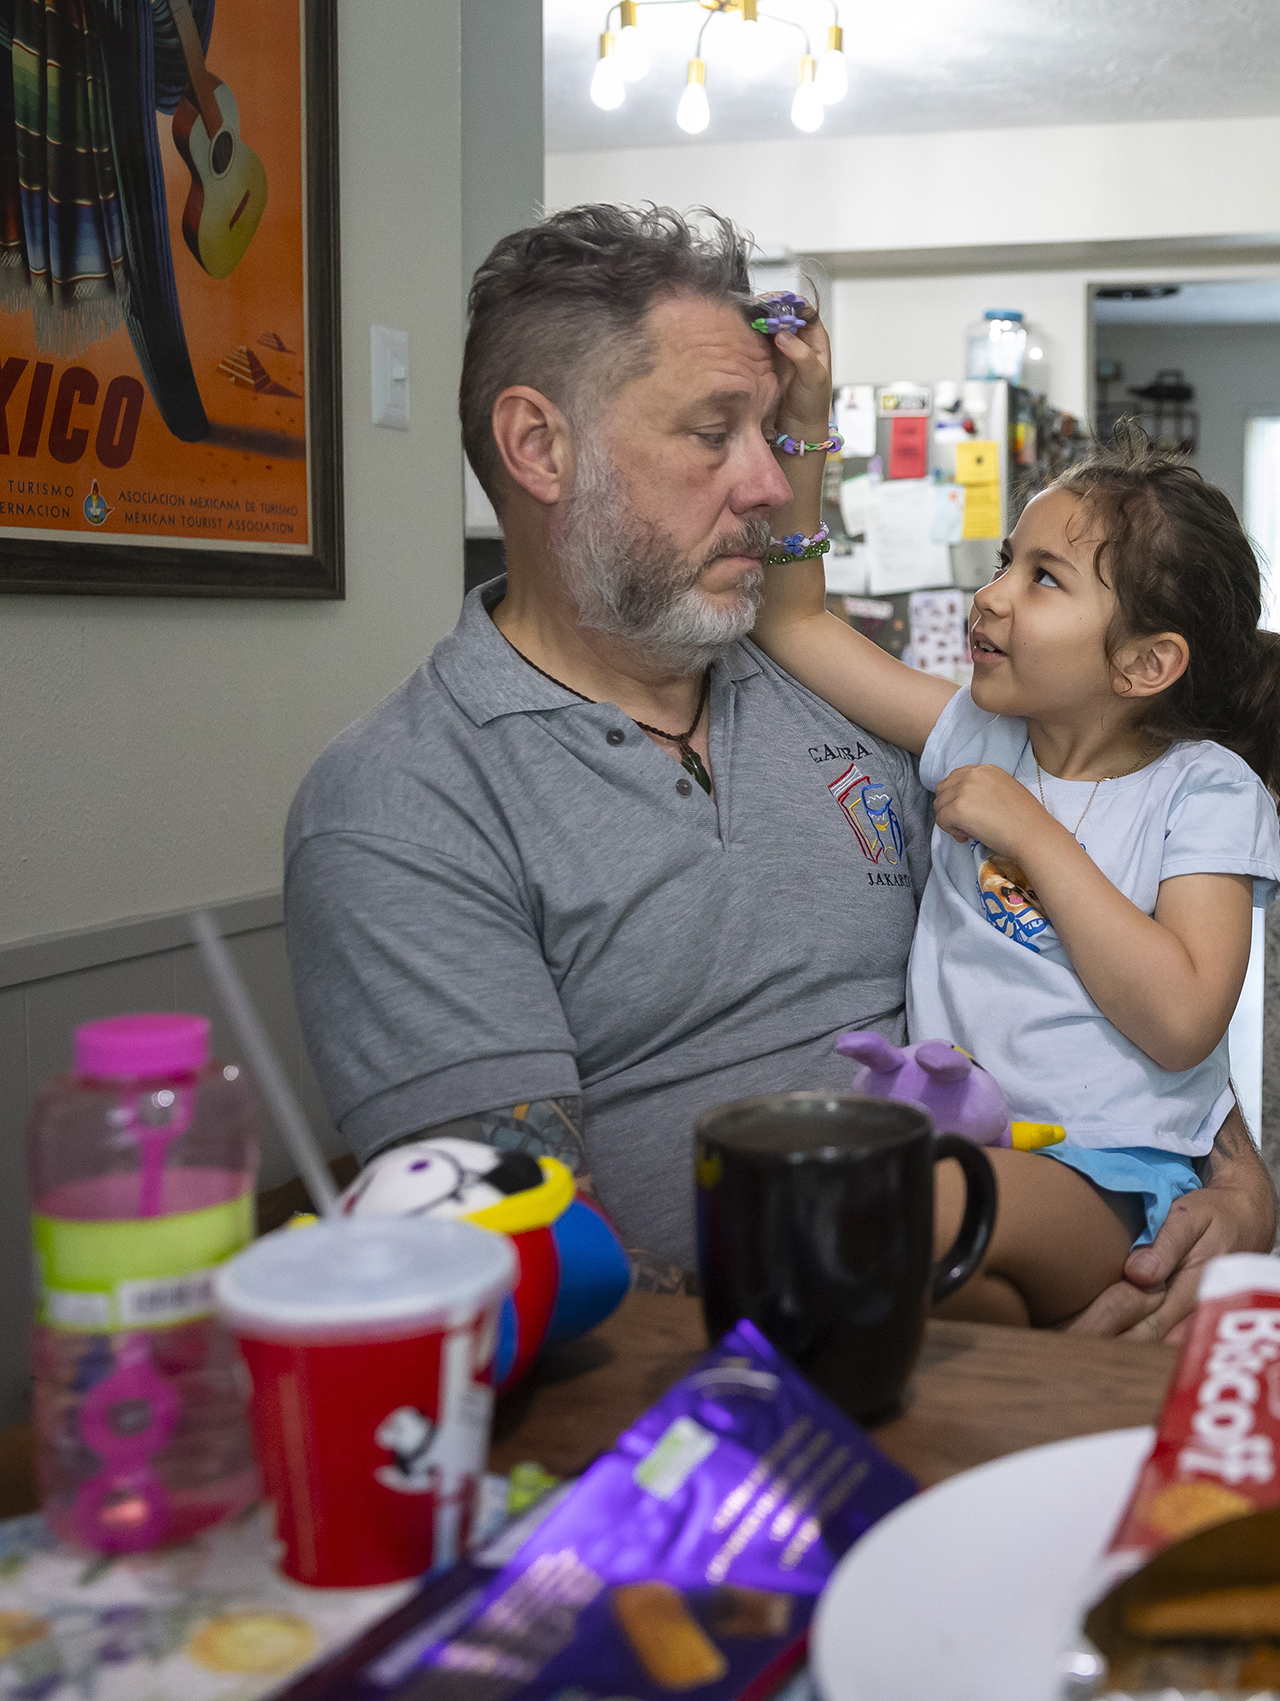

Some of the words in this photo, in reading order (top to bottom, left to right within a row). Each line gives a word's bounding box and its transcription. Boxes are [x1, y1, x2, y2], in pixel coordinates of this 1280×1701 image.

[8, 479, 75, 498] TURISMO
[0, 501, 71, 519] ERNACION
[118, 490, 186, 507] ASOCIACION
[189, 496, 241, 511] MEXICANA
[245, 500, 256, 513] DE
[260, 501, 298, 517] TURISMO
[124, 512, 176, 526] MEXICAN
[181, 515, 223, 530] TOURIST
[227, 519, 294, 535] ASSOCIATION
